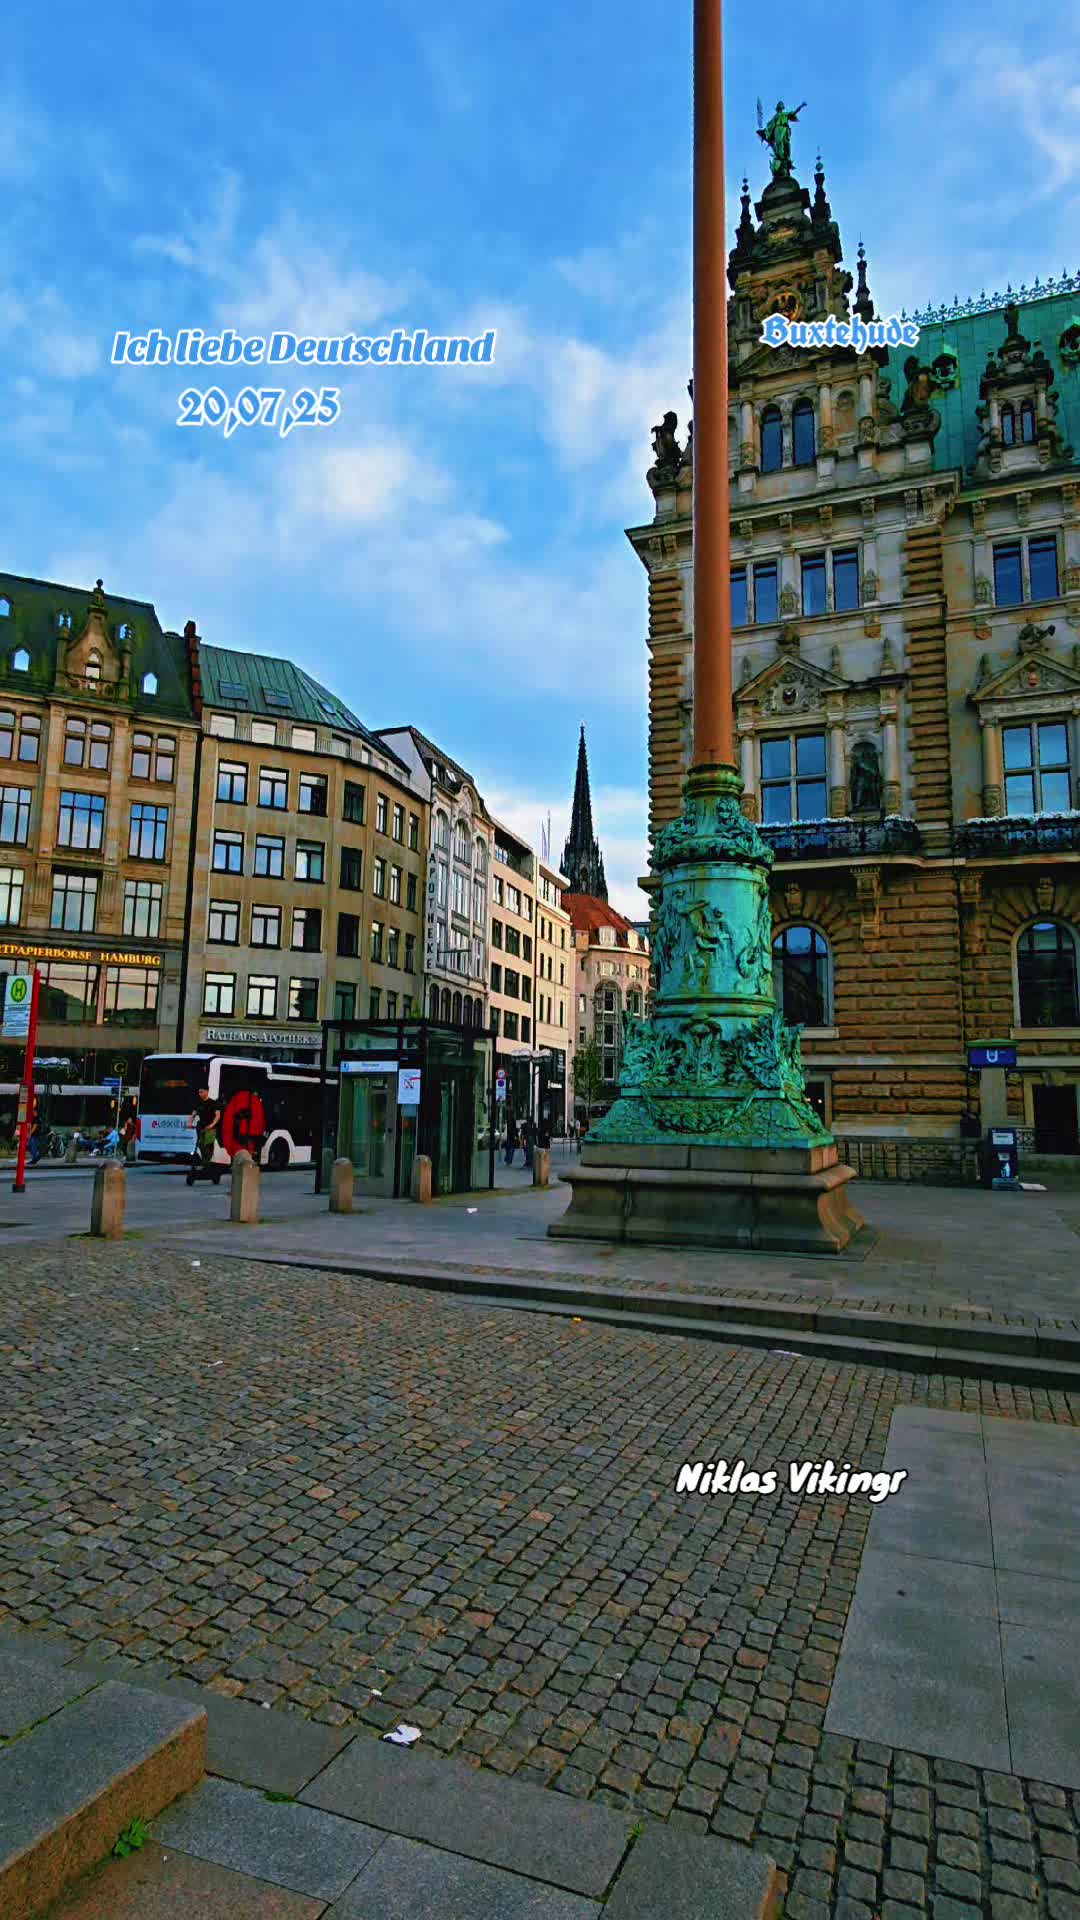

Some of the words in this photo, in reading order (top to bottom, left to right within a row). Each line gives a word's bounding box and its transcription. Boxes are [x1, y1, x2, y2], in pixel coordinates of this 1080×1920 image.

[427, 853, 436, 969] APOTHEKE
[101, 952, 161, 966] HAMBURG
[986, 1049, 998, 1063] U
